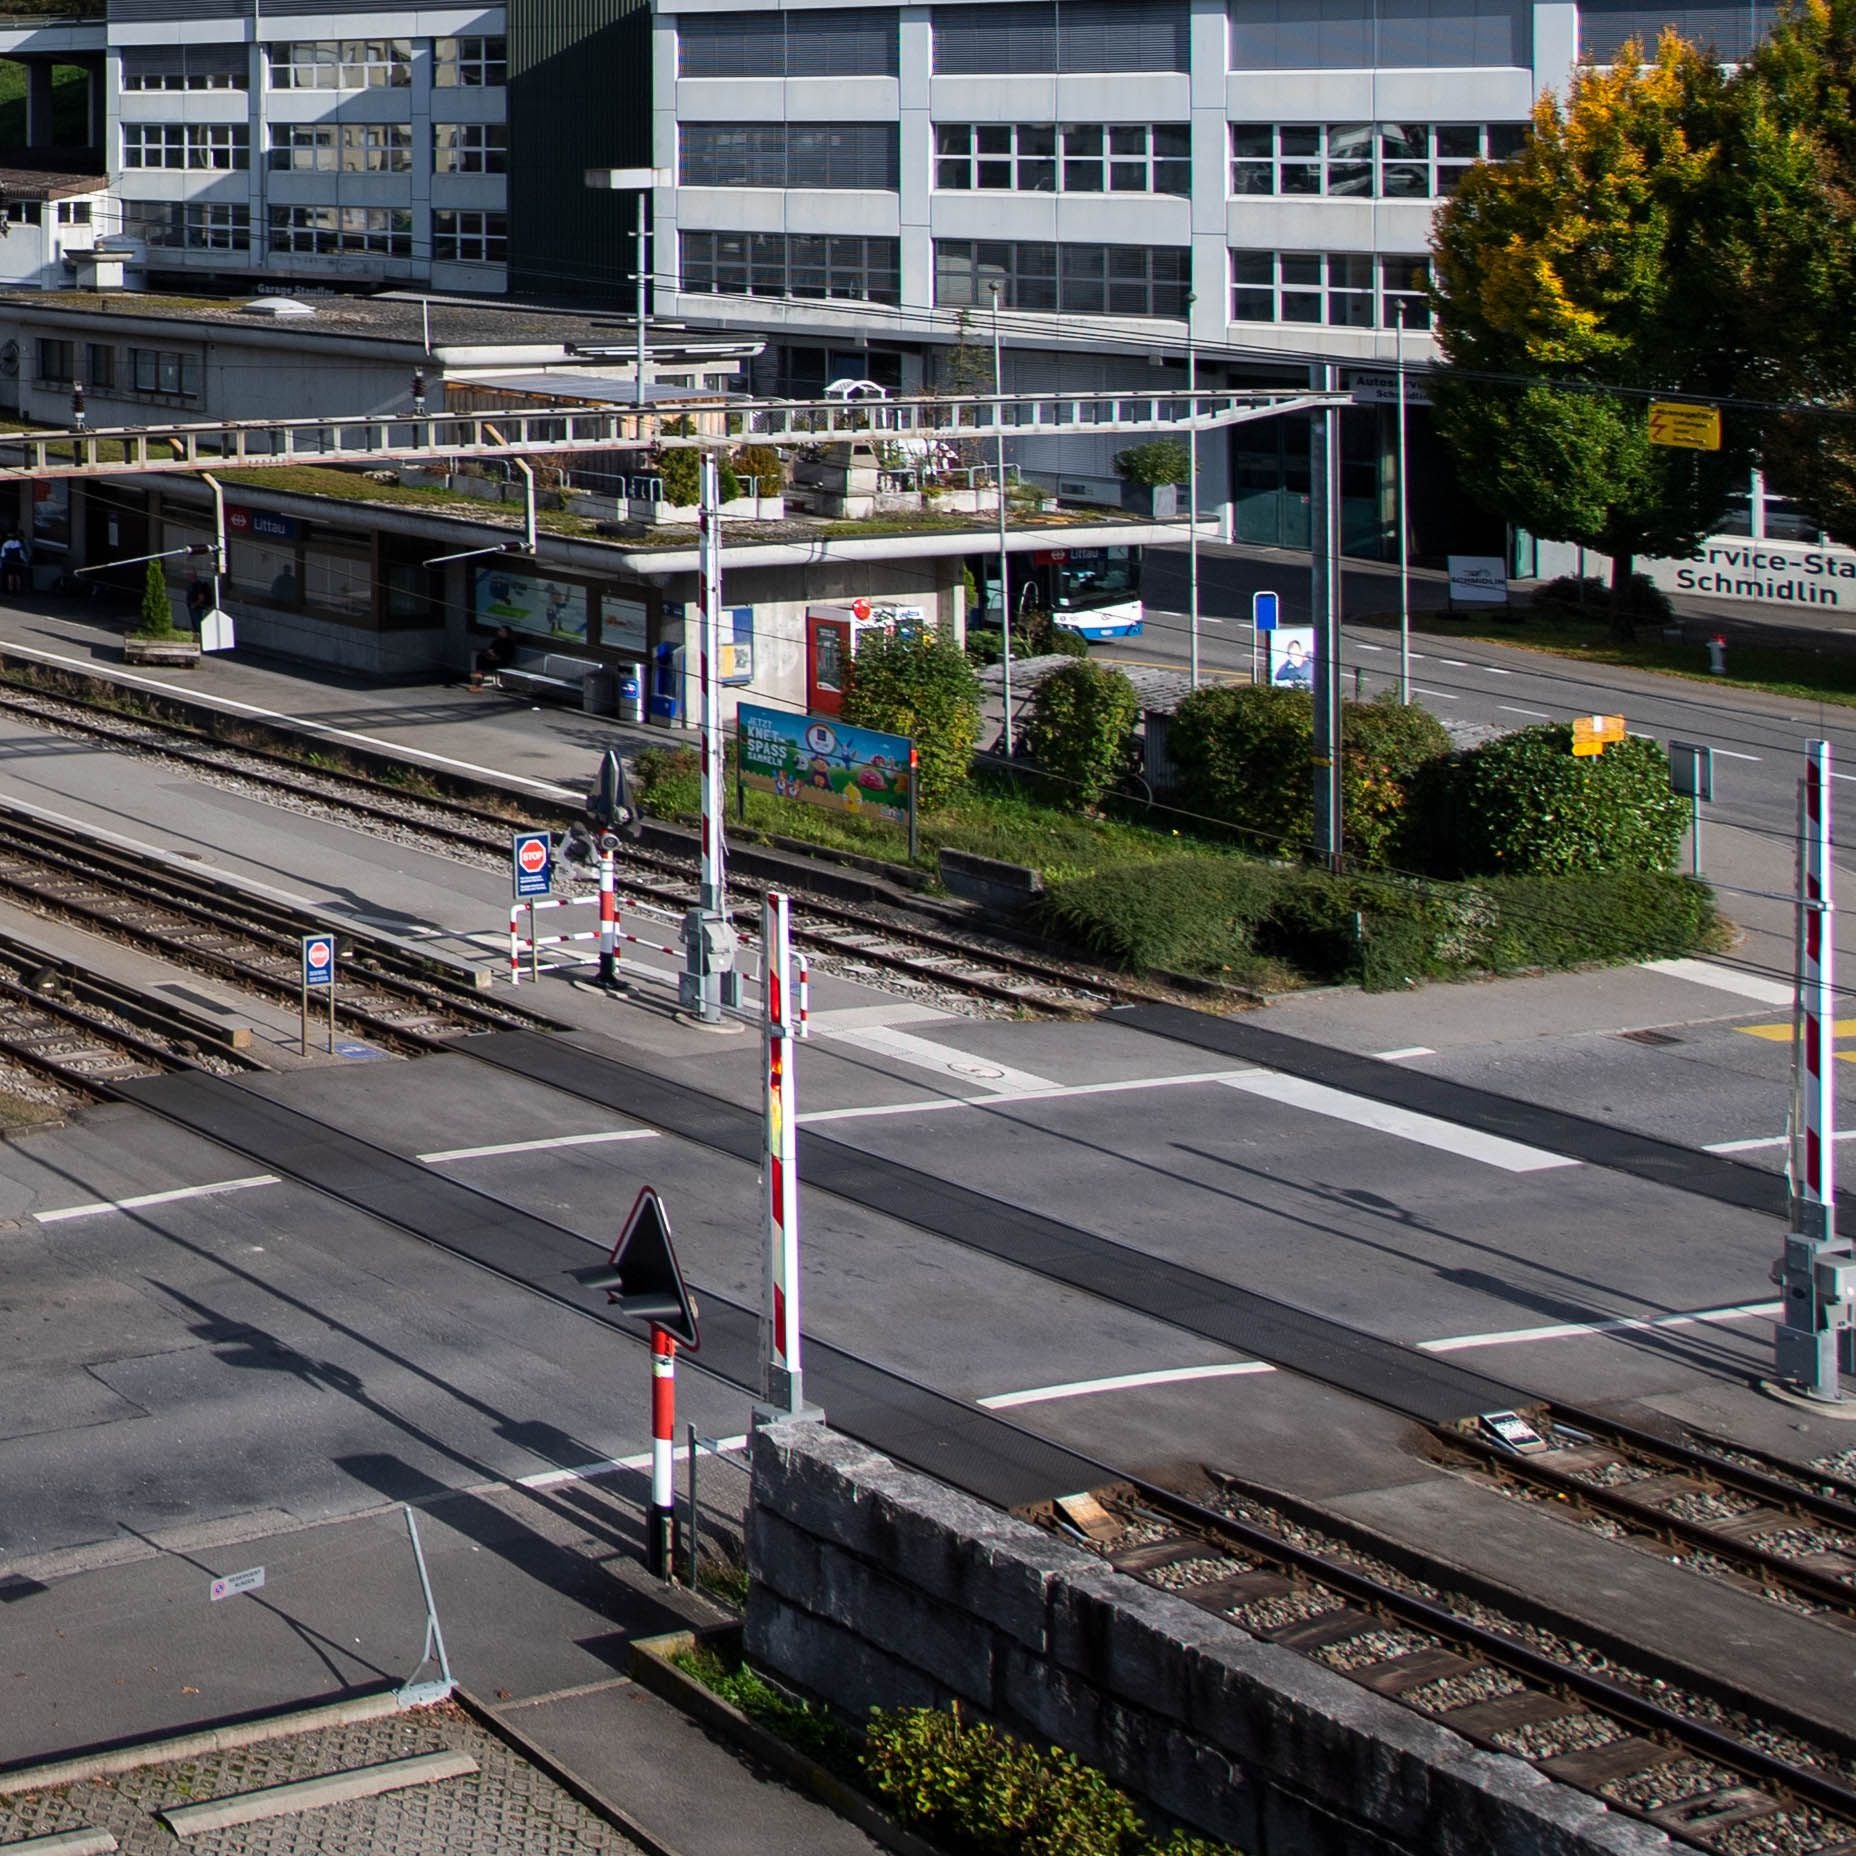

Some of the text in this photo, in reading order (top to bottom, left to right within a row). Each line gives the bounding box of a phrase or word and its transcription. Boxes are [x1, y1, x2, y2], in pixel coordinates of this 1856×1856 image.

[254, 517, 287, 535] Littau
[1676, 568, 1839, 605] Schmidlin
[748, 739, 787, 759] SPASS
[522, 851, 544, 861] STOP
